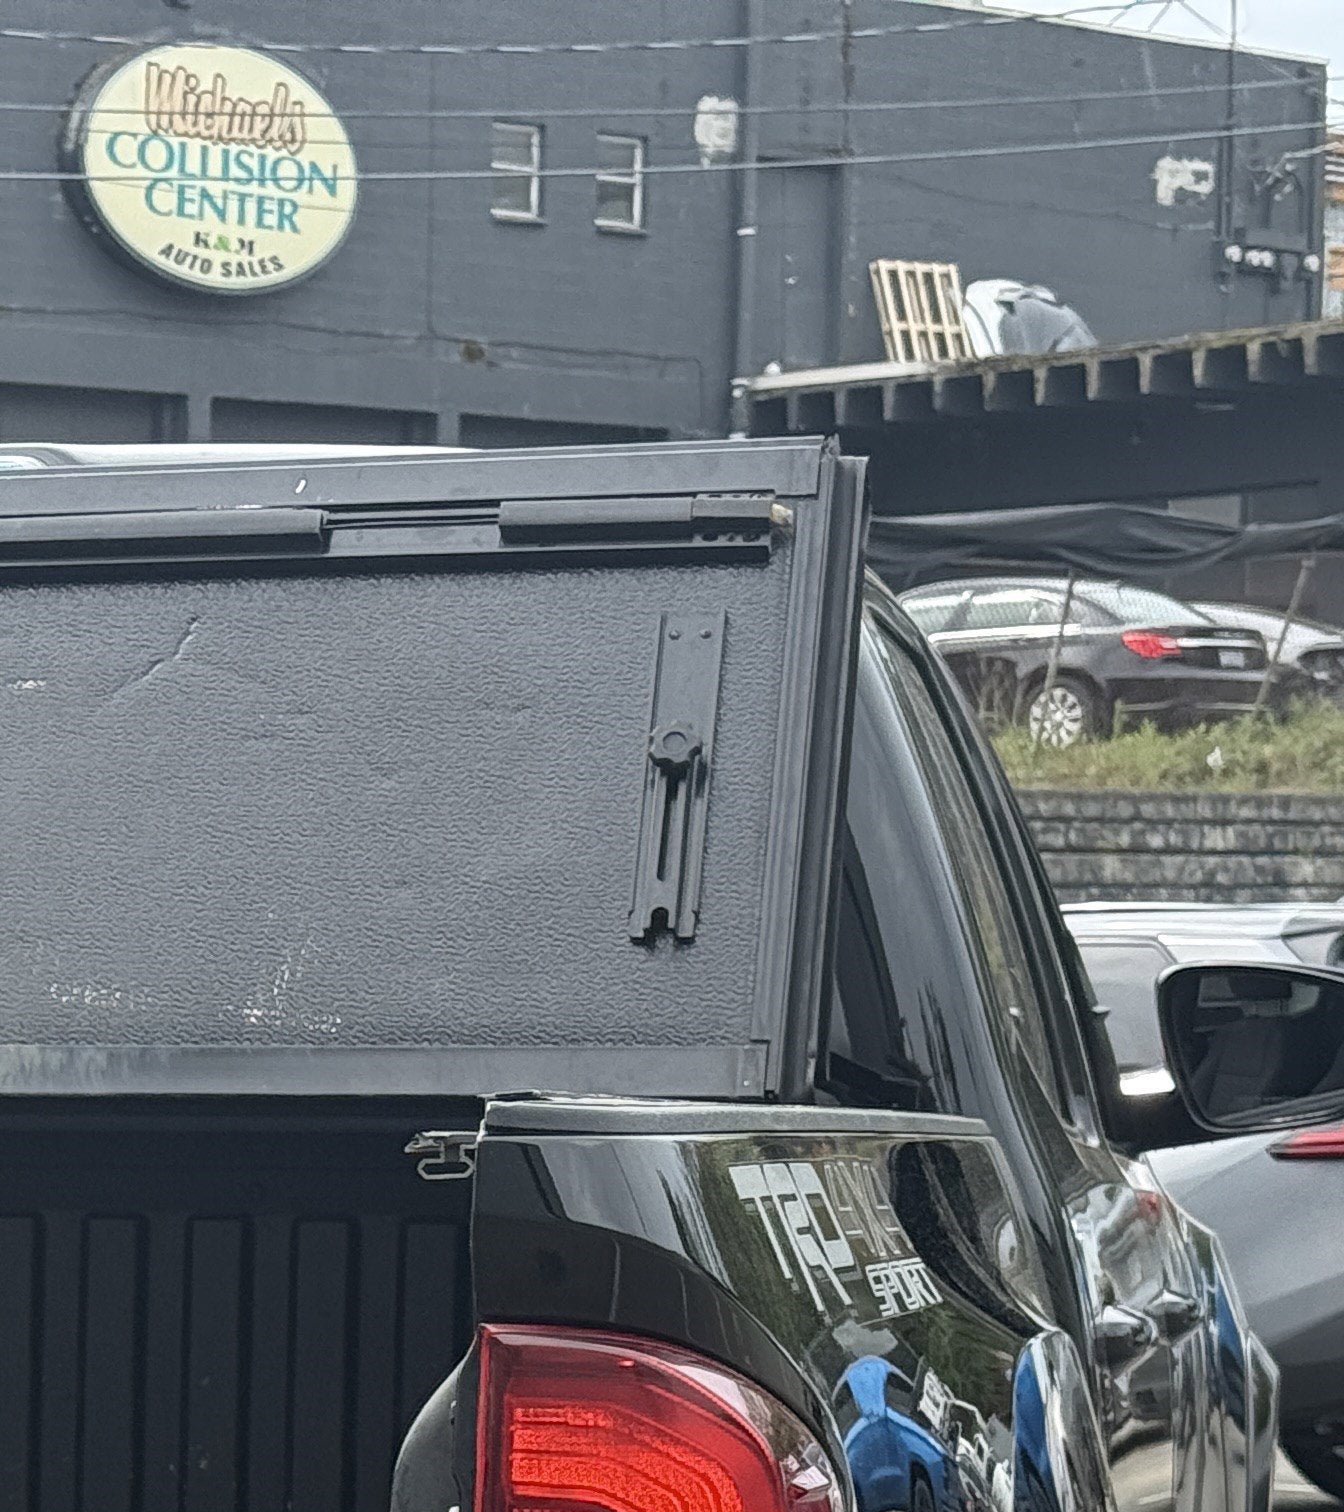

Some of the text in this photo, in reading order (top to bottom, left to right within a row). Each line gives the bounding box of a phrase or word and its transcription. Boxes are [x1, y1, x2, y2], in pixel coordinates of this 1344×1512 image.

[105, 131, 338, 198] COLLISION
[144, 178, 301, 234] CENTER
[157, 243, 286, 278] AUTO SALES
[728, 1161, 855, 1314] TRD
[865, 1257, 944, 1318] SPORT
